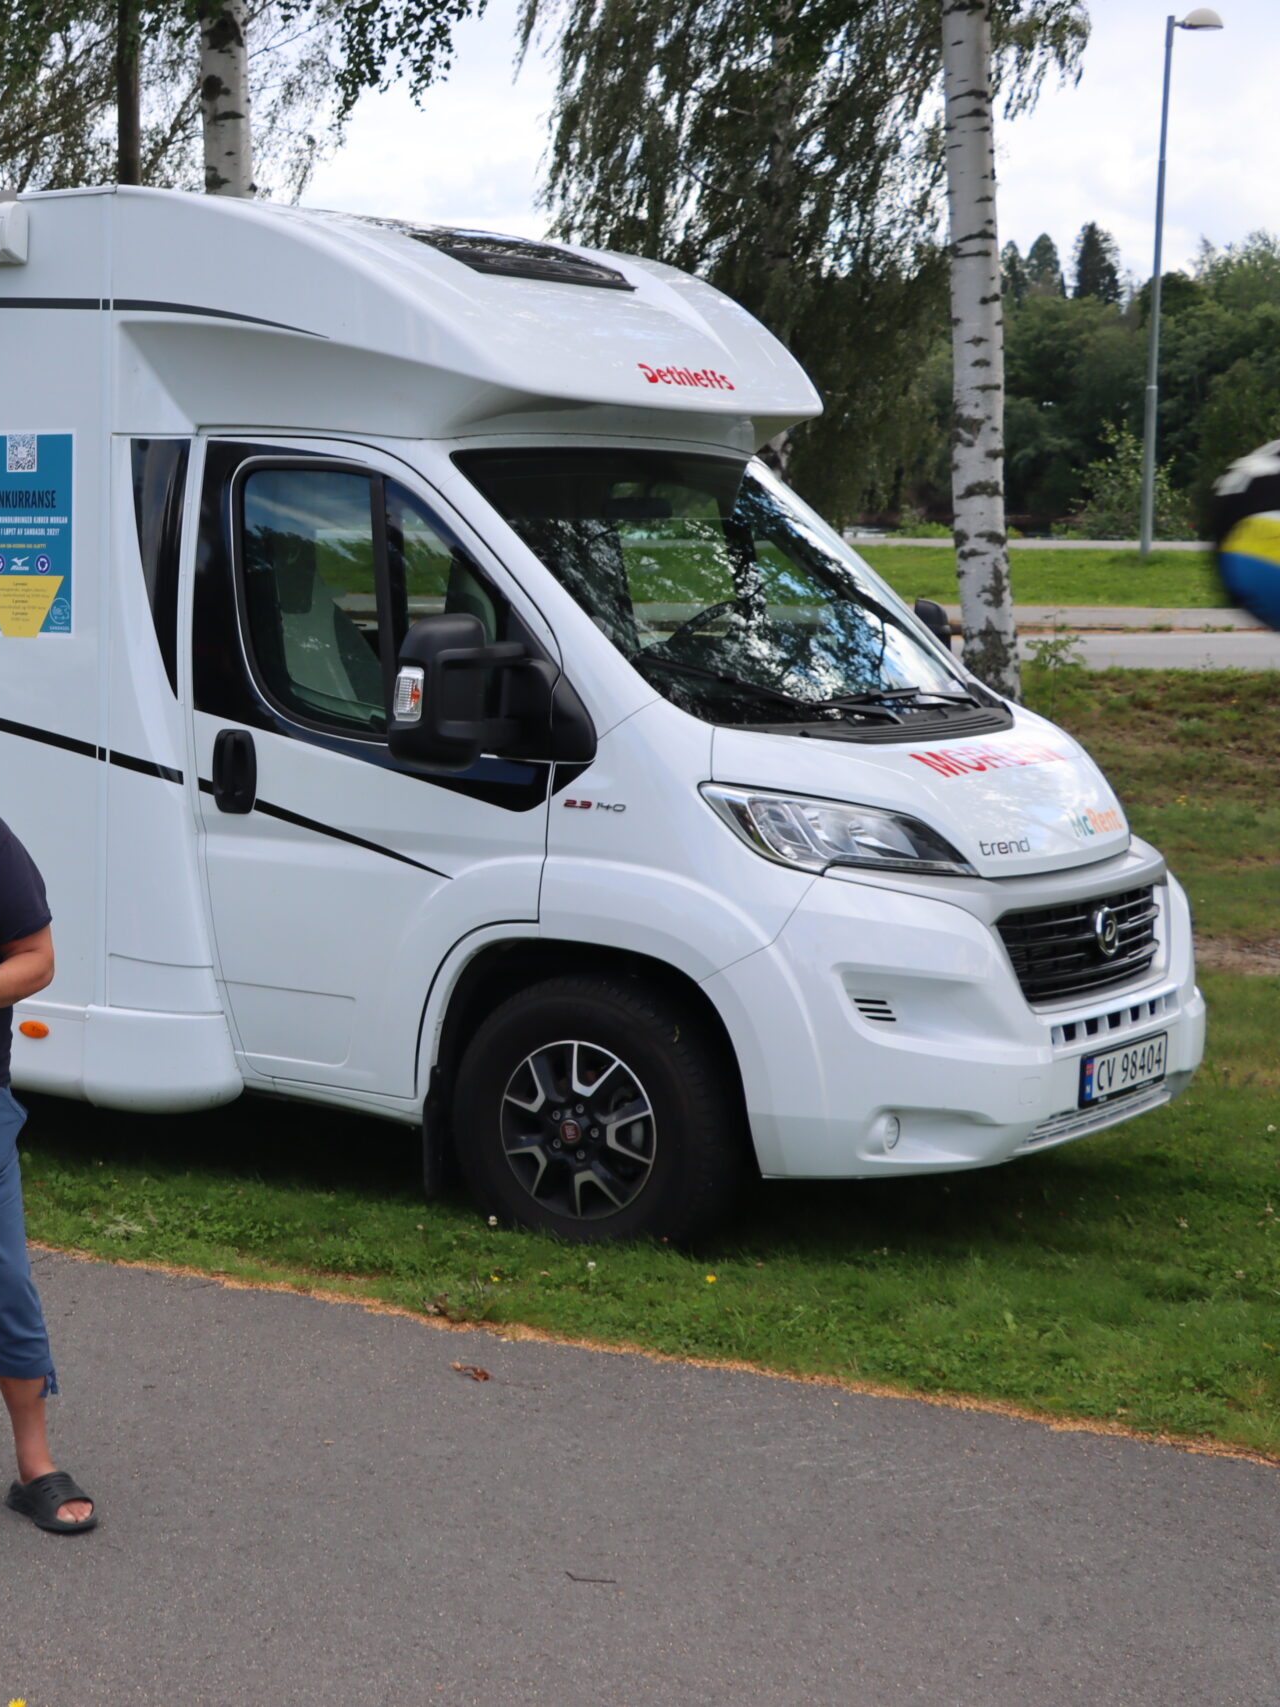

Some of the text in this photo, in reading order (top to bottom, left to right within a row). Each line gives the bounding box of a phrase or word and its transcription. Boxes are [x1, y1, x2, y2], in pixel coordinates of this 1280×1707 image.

[637, 363, 735, 391] Dethleffs
[1070, 806, 1125, 838] McRent
[979, 837, 1031, 857] trend
[1097, 1041, 1163, 1091] CV 98404
